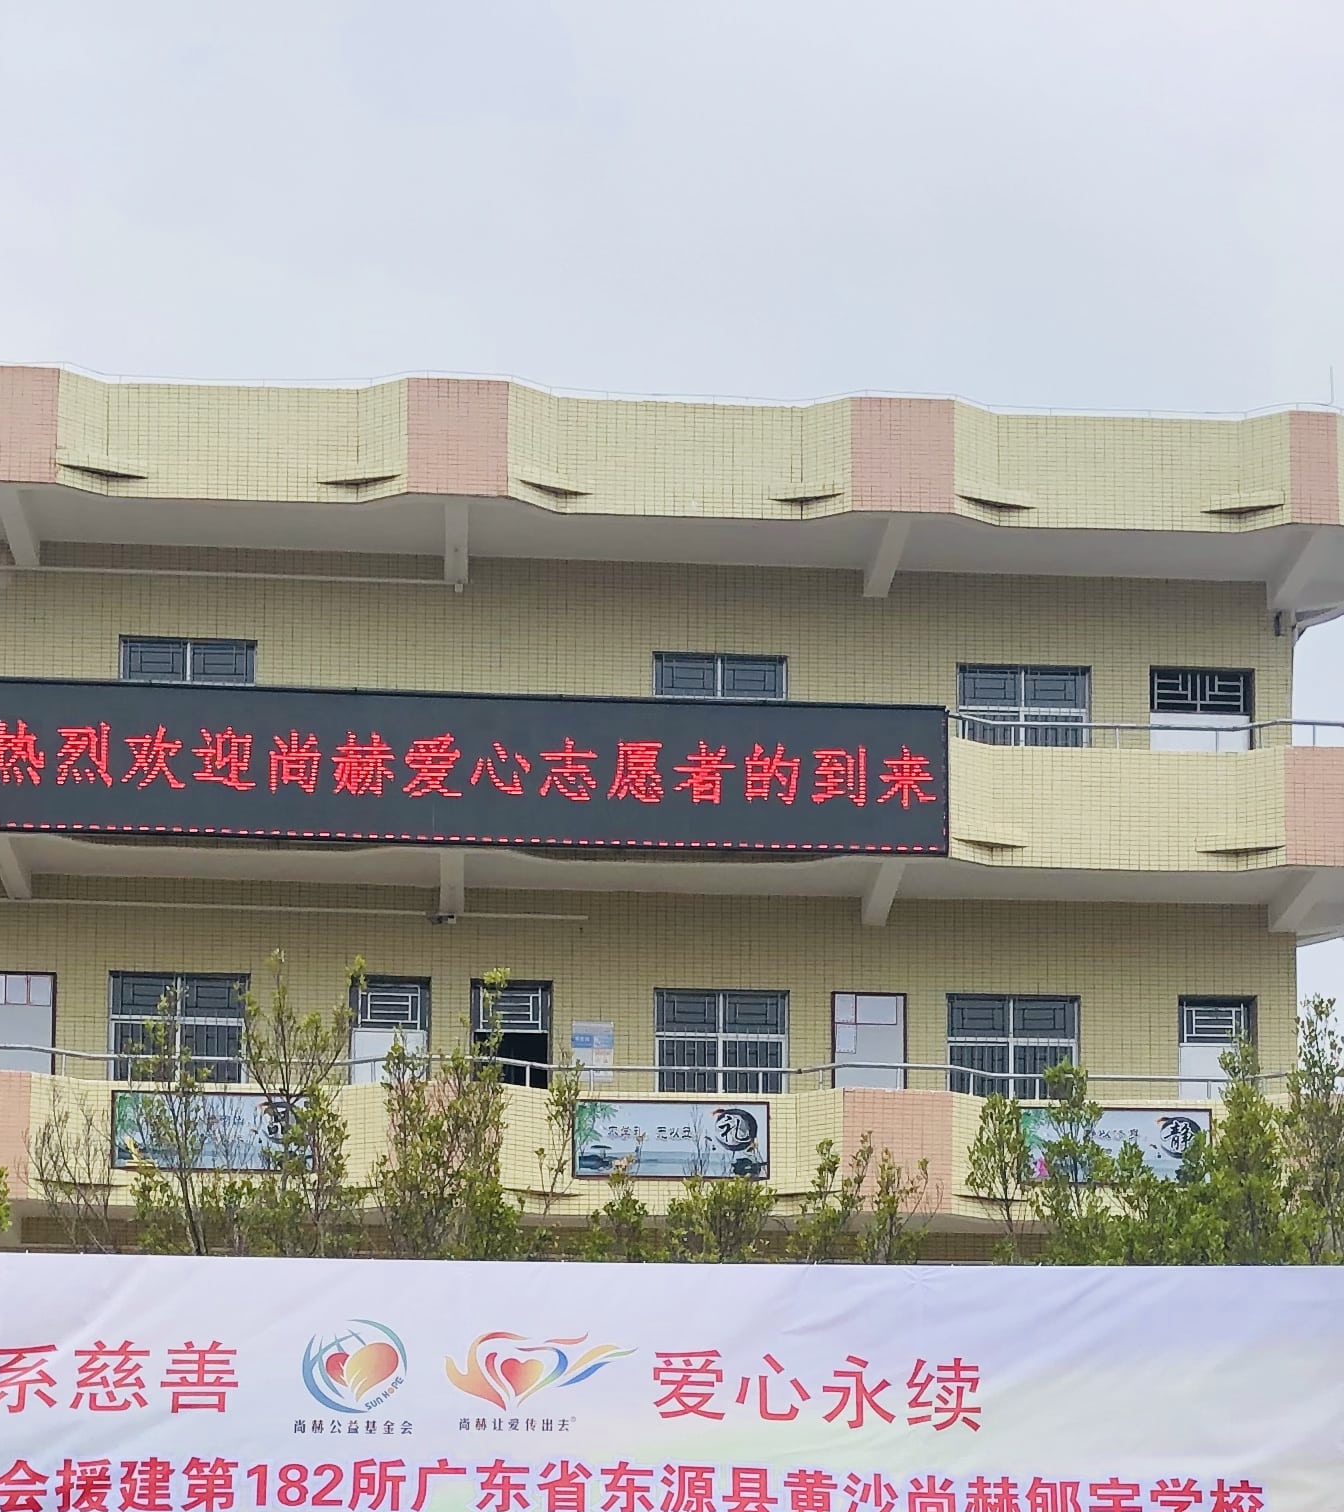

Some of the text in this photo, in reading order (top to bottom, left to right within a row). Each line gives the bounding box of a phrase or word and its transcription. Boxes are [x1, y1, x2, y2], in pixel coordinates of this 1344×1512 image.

[652, 1349, 982, 1432] 爱心永续
[293, 1418, 413, 1436] 尚赫公益基金会
[458, 1417, 570, 1432] 尚赫让爱传出去
